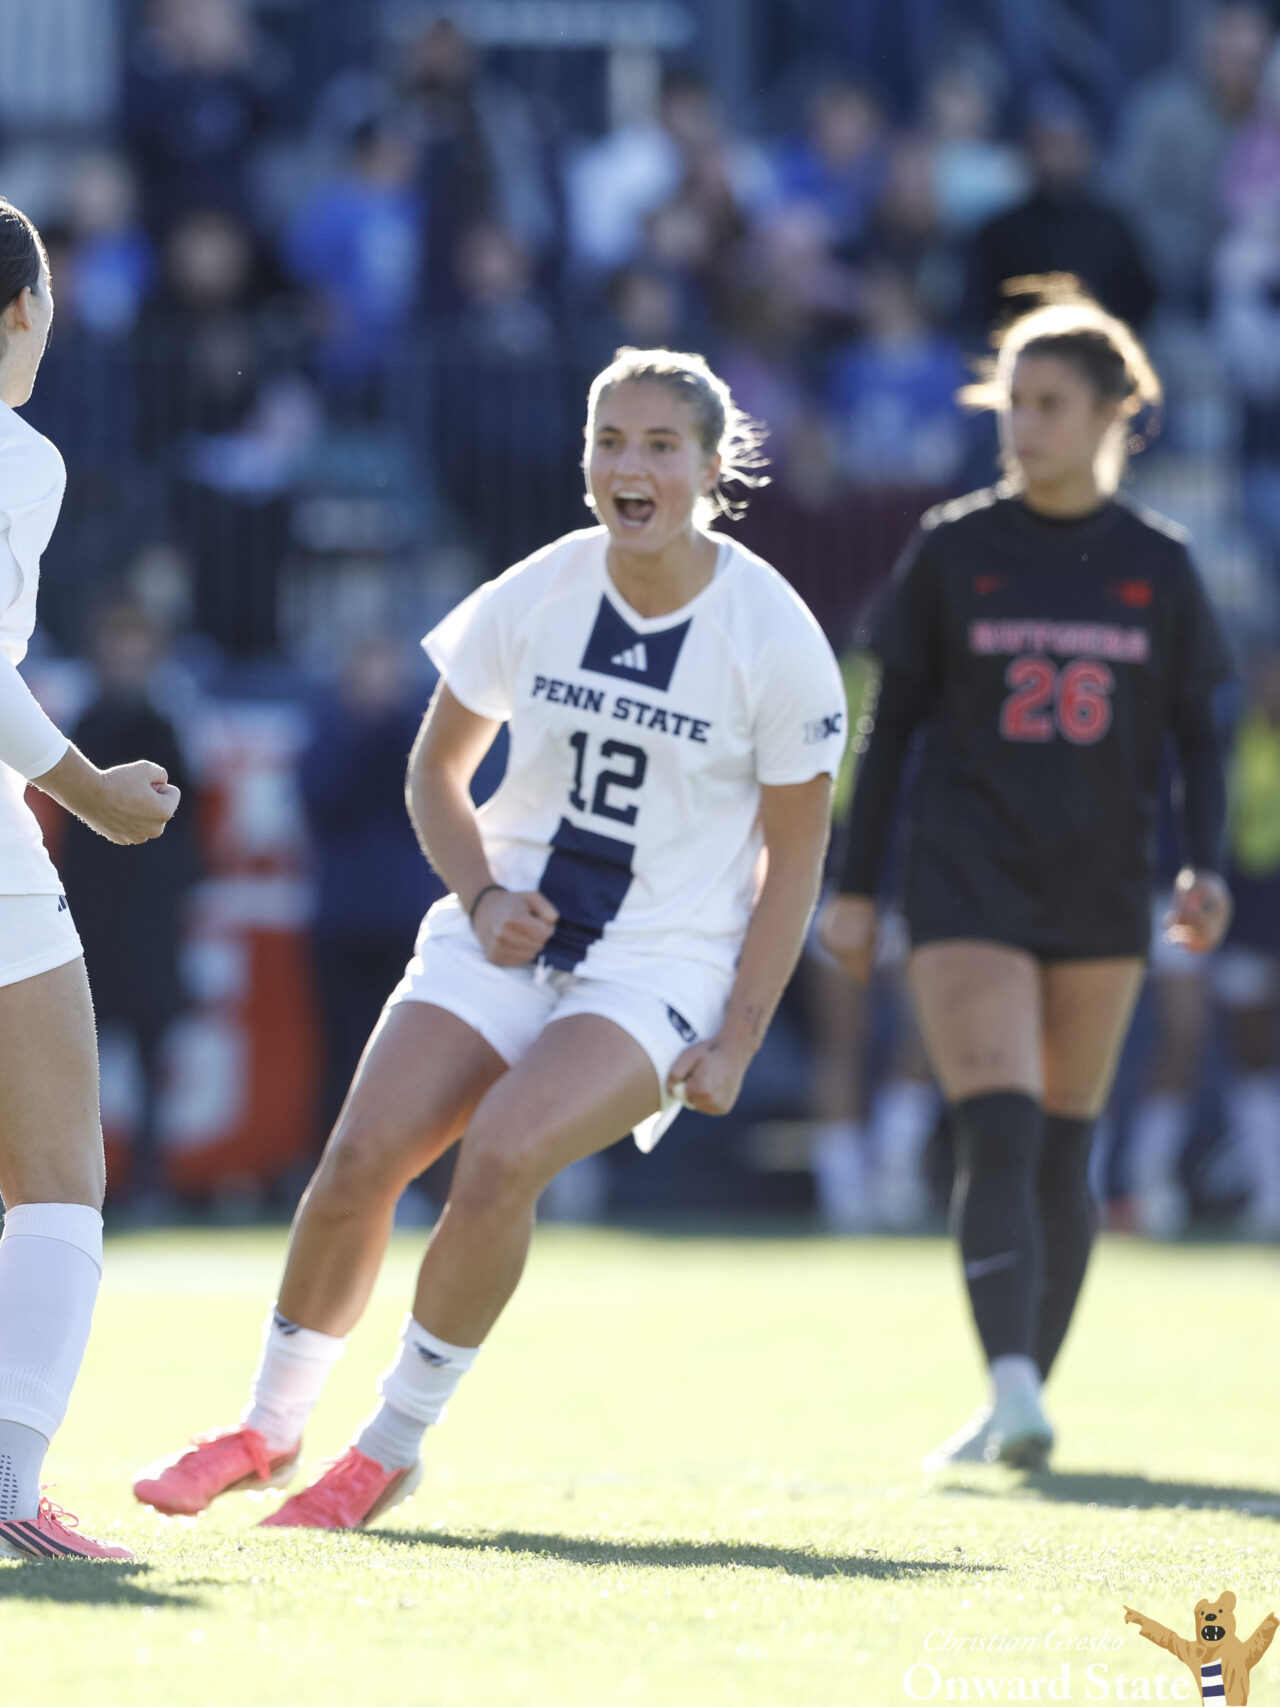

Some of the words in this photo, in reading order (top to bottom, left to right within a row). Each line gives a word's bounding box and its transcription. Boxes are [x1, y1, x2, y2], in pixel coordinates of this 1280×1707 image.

[531, 675, 605, 713] PENN
[612, 697, 712, 743] STATE
[999, 656, 1114, 745] 26
[569, 730, 648, 826] 12
